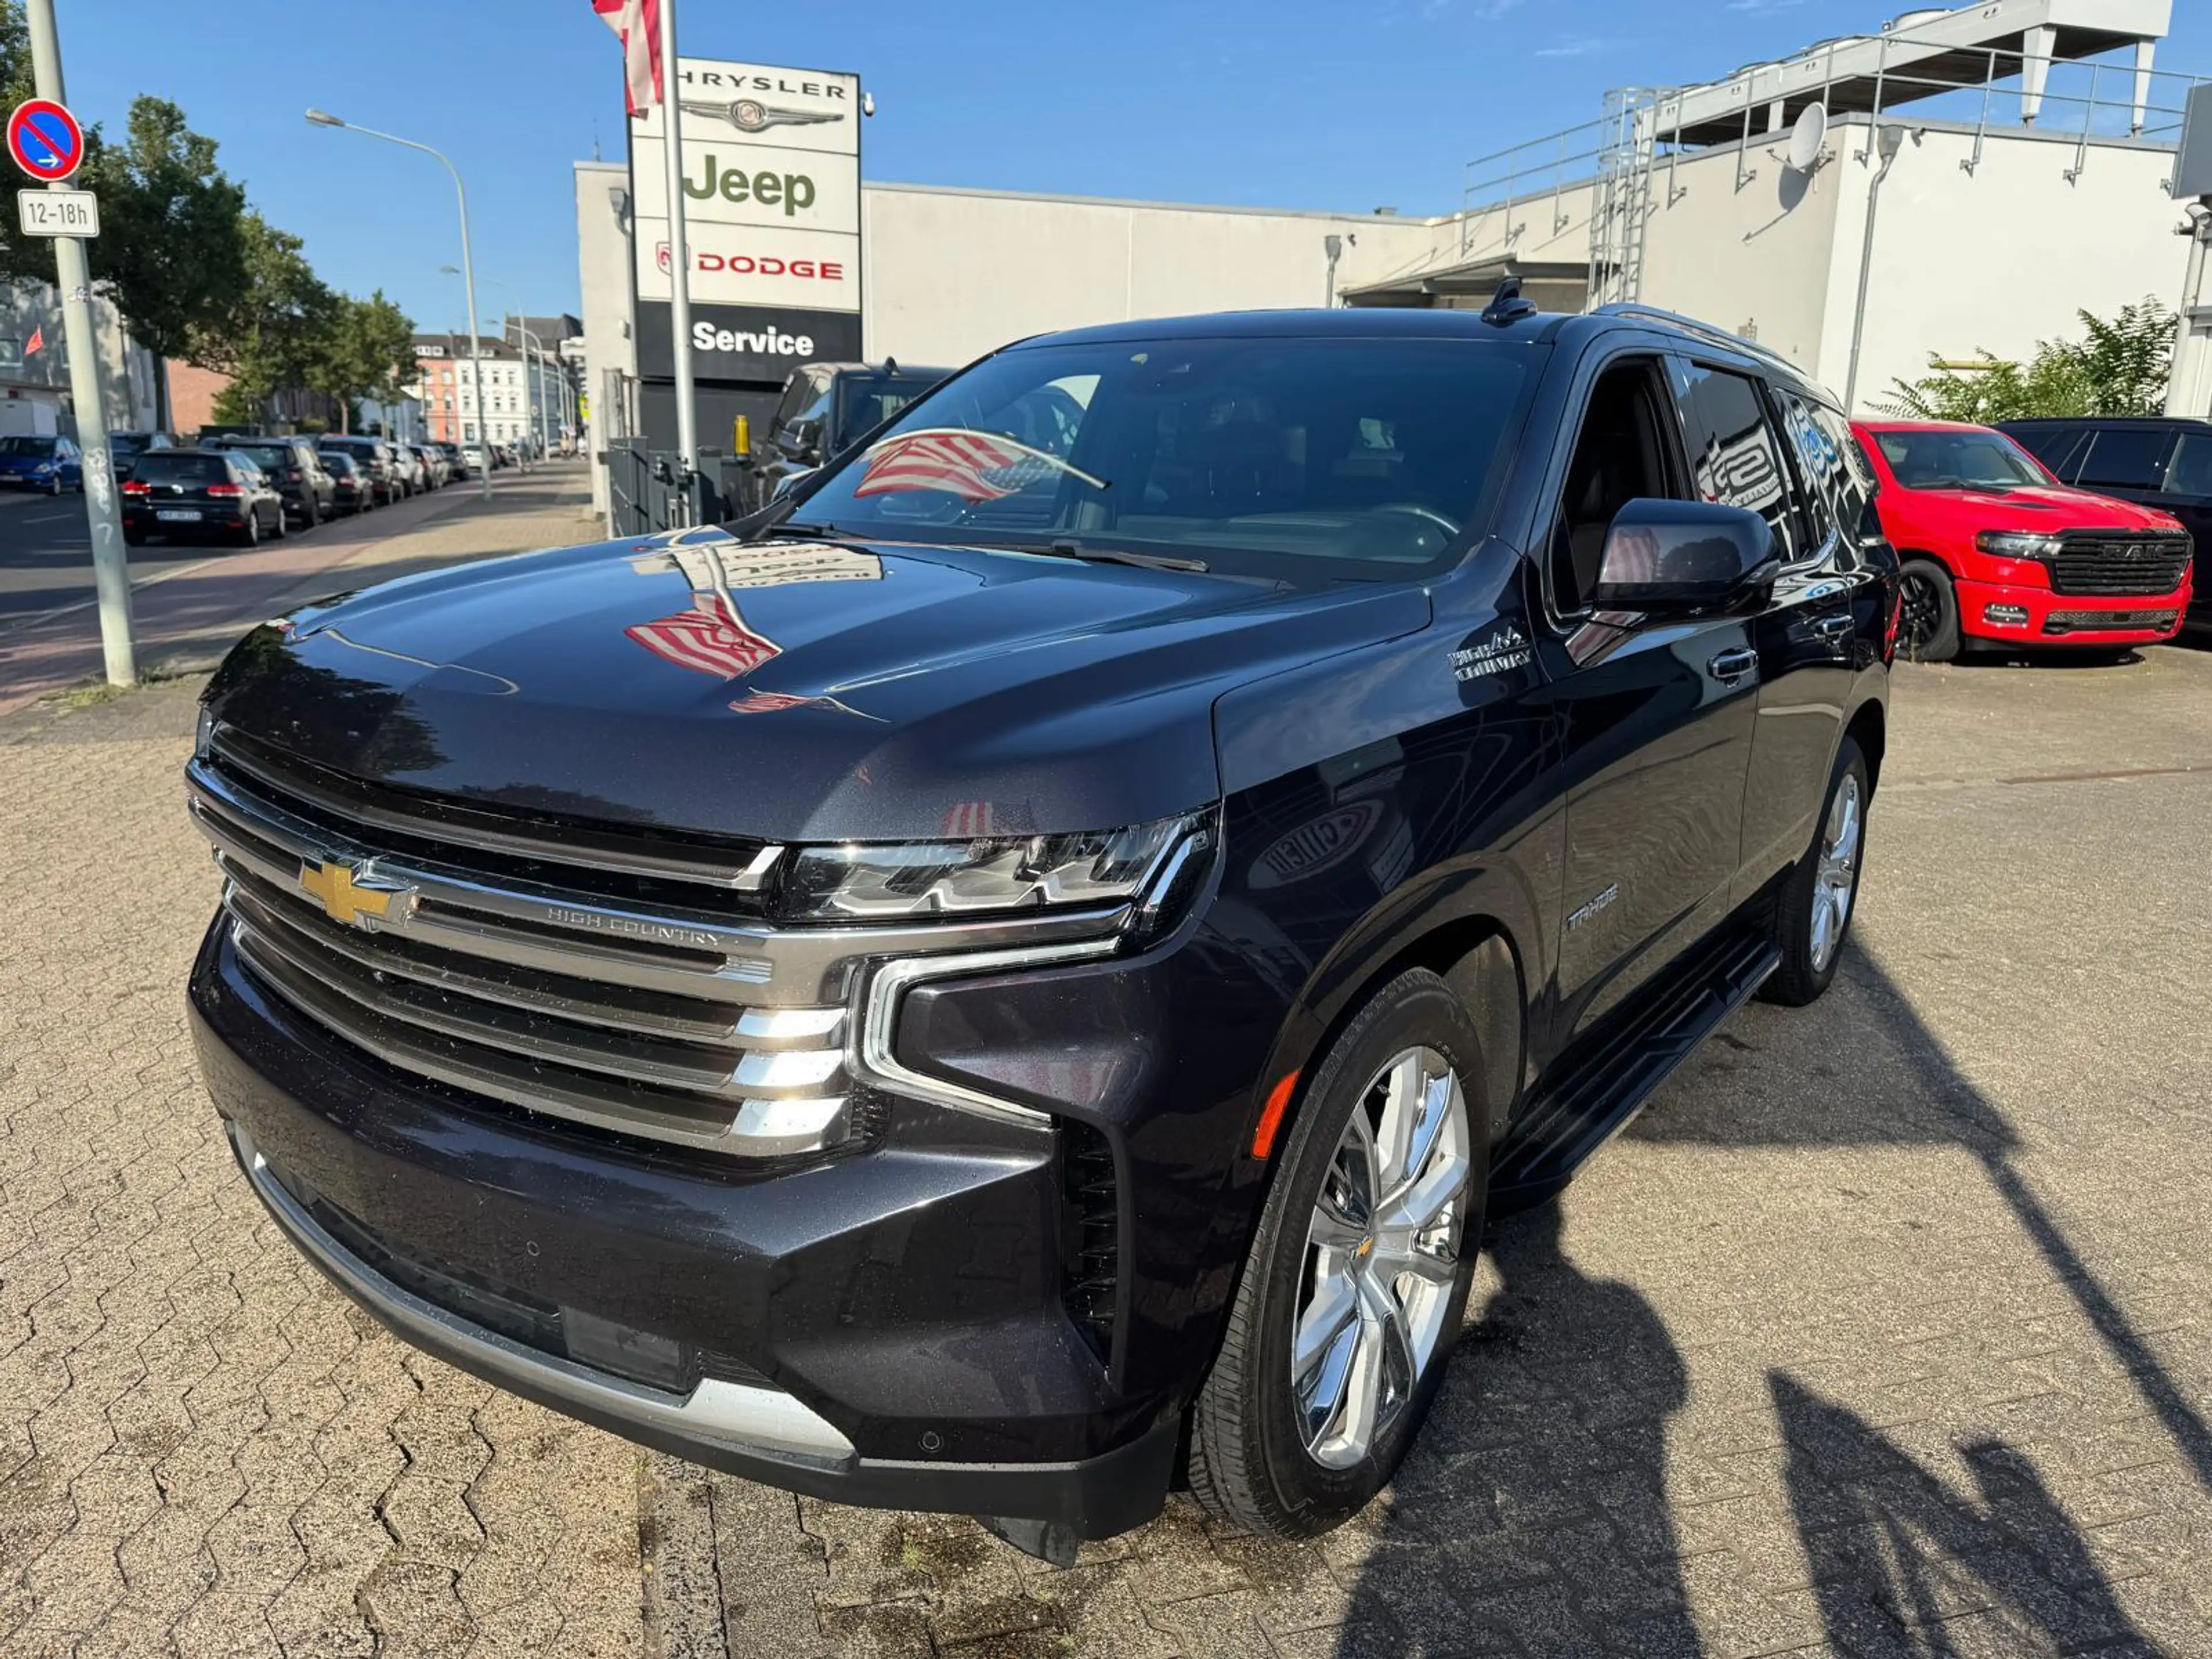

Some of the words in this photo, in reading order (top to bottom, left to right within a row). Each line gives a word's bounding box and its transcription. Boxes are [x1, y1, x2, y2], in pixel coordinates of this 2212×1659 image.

[677, 71, 846, 99] HRYSLER
[682, 154, 815, 215] Jeep
[698, 253, 843, 281] DODGE
[692, 320, 814, 356] Service
[548, 908, 601, 928] HIGH
[610, 918, 724, 946] COUNTRY
